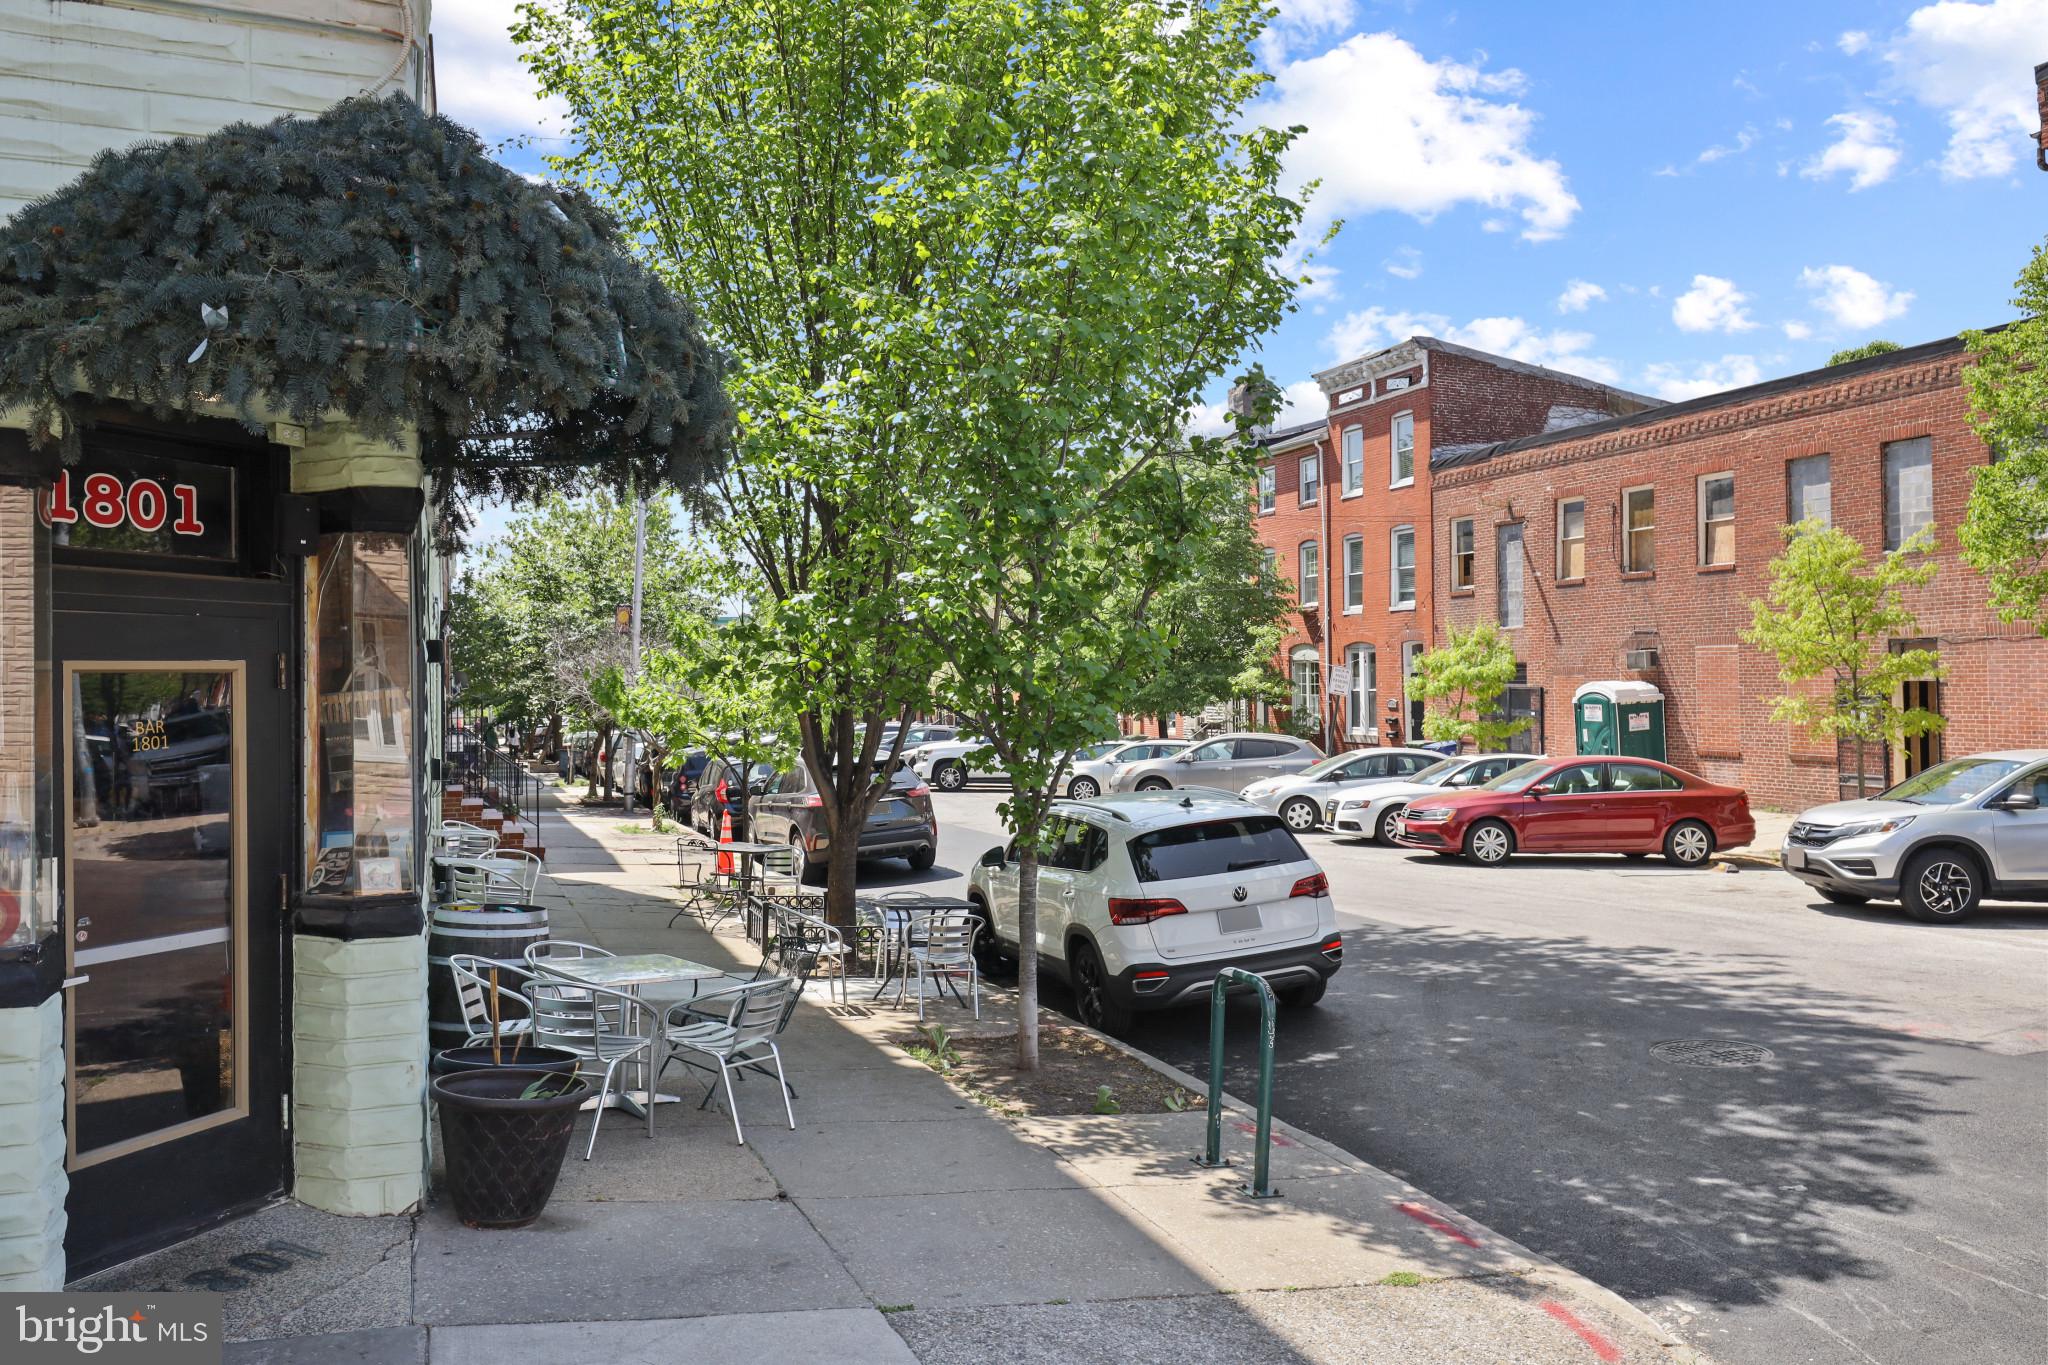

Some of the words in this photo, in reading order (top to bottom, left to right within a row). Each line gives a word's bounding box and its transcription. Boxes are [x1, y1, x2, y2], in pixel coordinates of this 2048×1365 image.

[51, 468, 204, 536] 1801
[132, 735, 169, 752] 1801
[135, 719, 165, 735] BAR
[158, 1239, 323, 1292] 801
